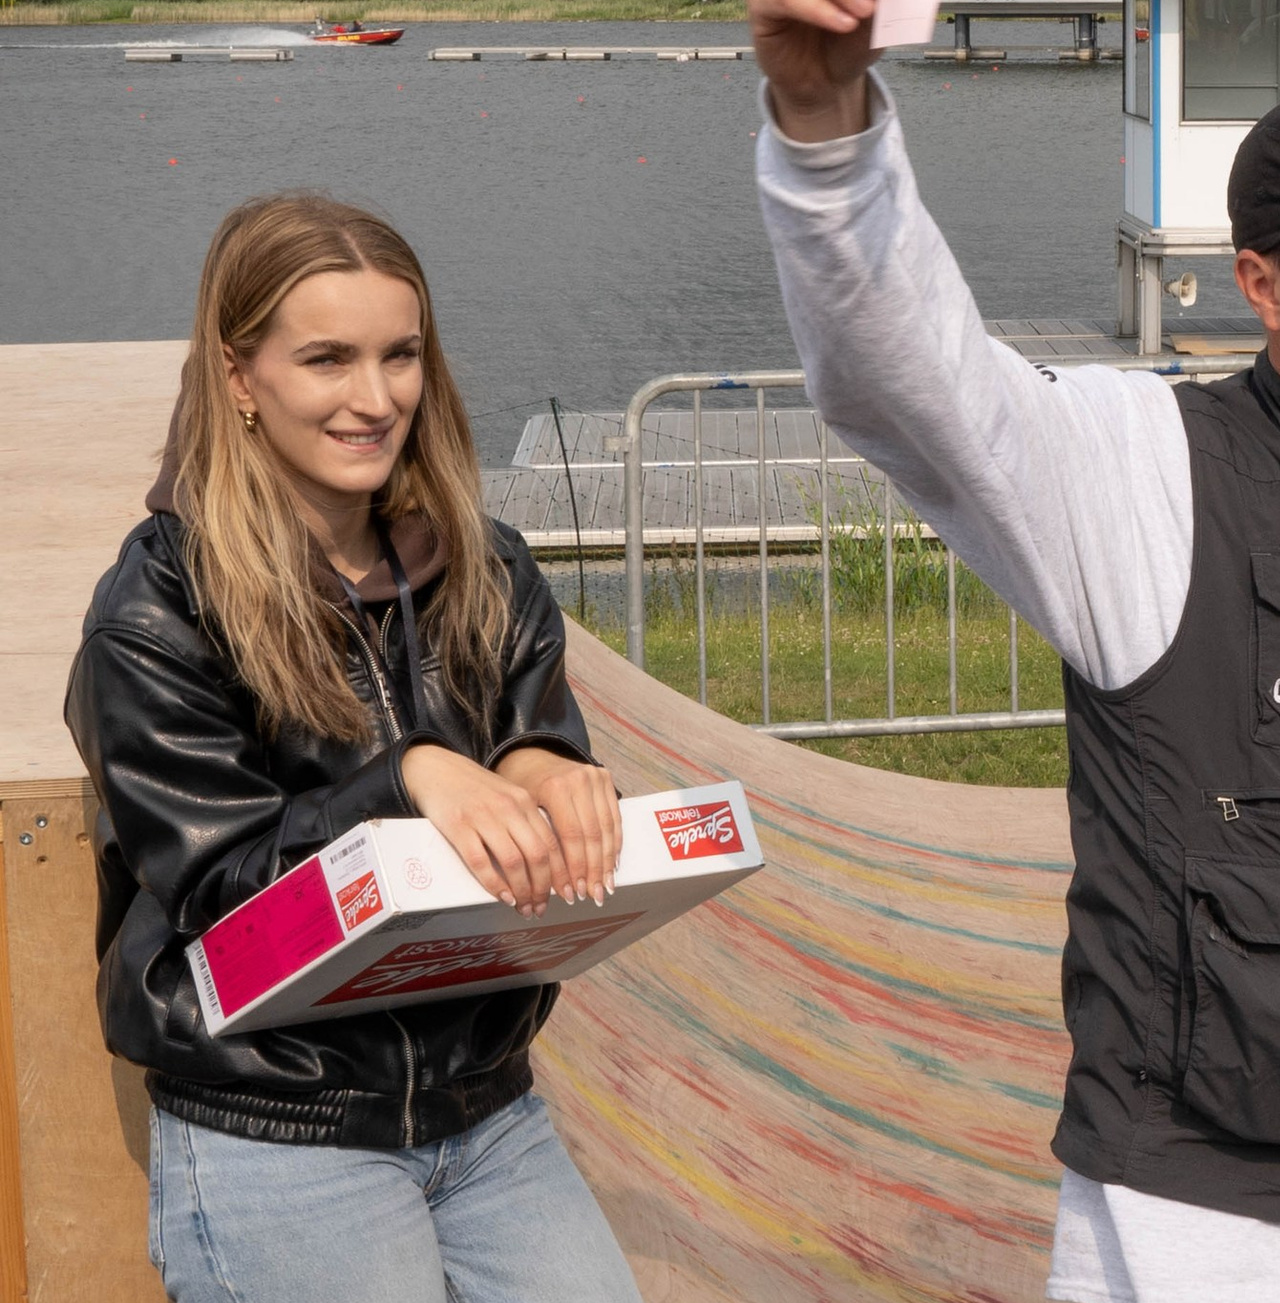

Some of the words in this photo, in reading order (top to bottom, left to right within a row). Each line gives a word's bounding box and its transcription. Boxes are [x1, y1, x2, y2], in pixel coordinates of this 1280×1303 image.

[659, 807, 701, 825] feinkost
[667, 813, 734, 856] Sprehe
[394, 929, 540, 961] feinkost
